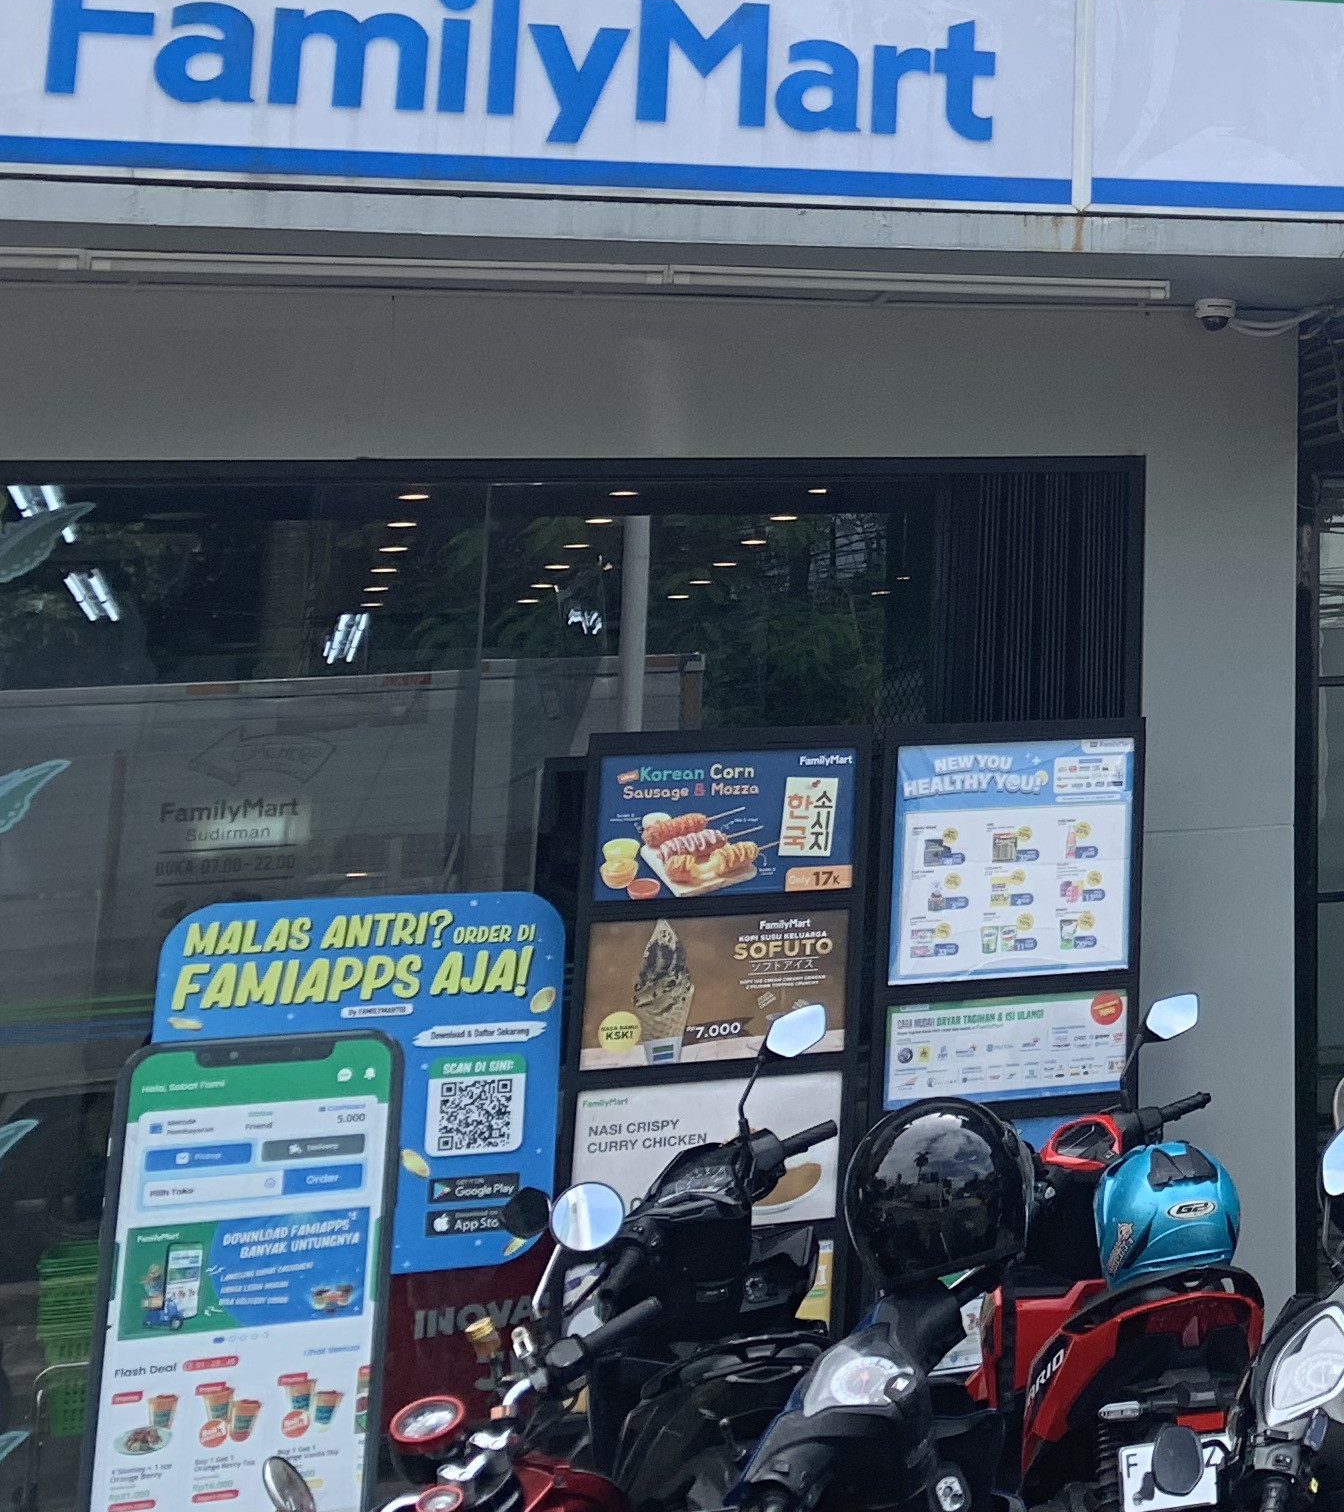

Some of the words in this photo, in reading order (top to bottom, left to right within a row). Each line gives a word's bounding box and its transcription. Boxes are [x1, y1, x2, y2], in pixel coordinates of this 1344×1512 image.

[799, 754, 852, 767] FamilyMart
[934, 755, 973, 774] NEW
[975, 753, 1013, 771] YOU
[640, 766, 704, 783] Korean
[710, 763, 755, 779] Corn
[623, 784, 690, 801] Sausage
[711, 781, 759, 796] Mozza
[903, 772, 994, 798] HEALTHY
[160, 797, 300, 824] FamilyMart
[186, 826, 270, 842] Sudirman
[183, 917, 313, 957] MALAS
[320, 909, 453, 952] ANTRI?
[453, 925, 513, 945] ORDER
[517, 924, 536, 943] DI
[759, 918, 811, 931] FamilyMart
[733, 938, 834, 960] SOFUTO
[171, 955, 423, 1010] FAMIAPPS
[430, 946, 535, 997] AJA!
[442, 1061, 472, 1074] SCAN
[474, 1060, 487, 1073] DI
[245, 1121, 273, 1131] Friend
[337, 1113, 366, 1124] 5.000
[588, 1123, 622, 1137] NASI
[626, 1118, 680, 1134] CRISPY
[587, 1137, 638, 1154] CURRY
[642, 1132, 707, 1149] CHICKEN
[305, 1173, 340, 1185] Order
[455, 1183, 492, 1198] Google
[493, 1182, 515, 1195] Play
[223, 1227, 288, 1246] DOWNLOAD
[290, 1219, 350, 1236] FAMIAPPS
[453, 1217, 477, 1232] App
[478, 1216, 500, 1229] Sto
[240, 1240, 288, 1259] BANYAK
[114, 1365, 147, 1378] Flash
[150, 1362, 177, 1374] Deal
[1126, 1453, 1138, 1478] F
